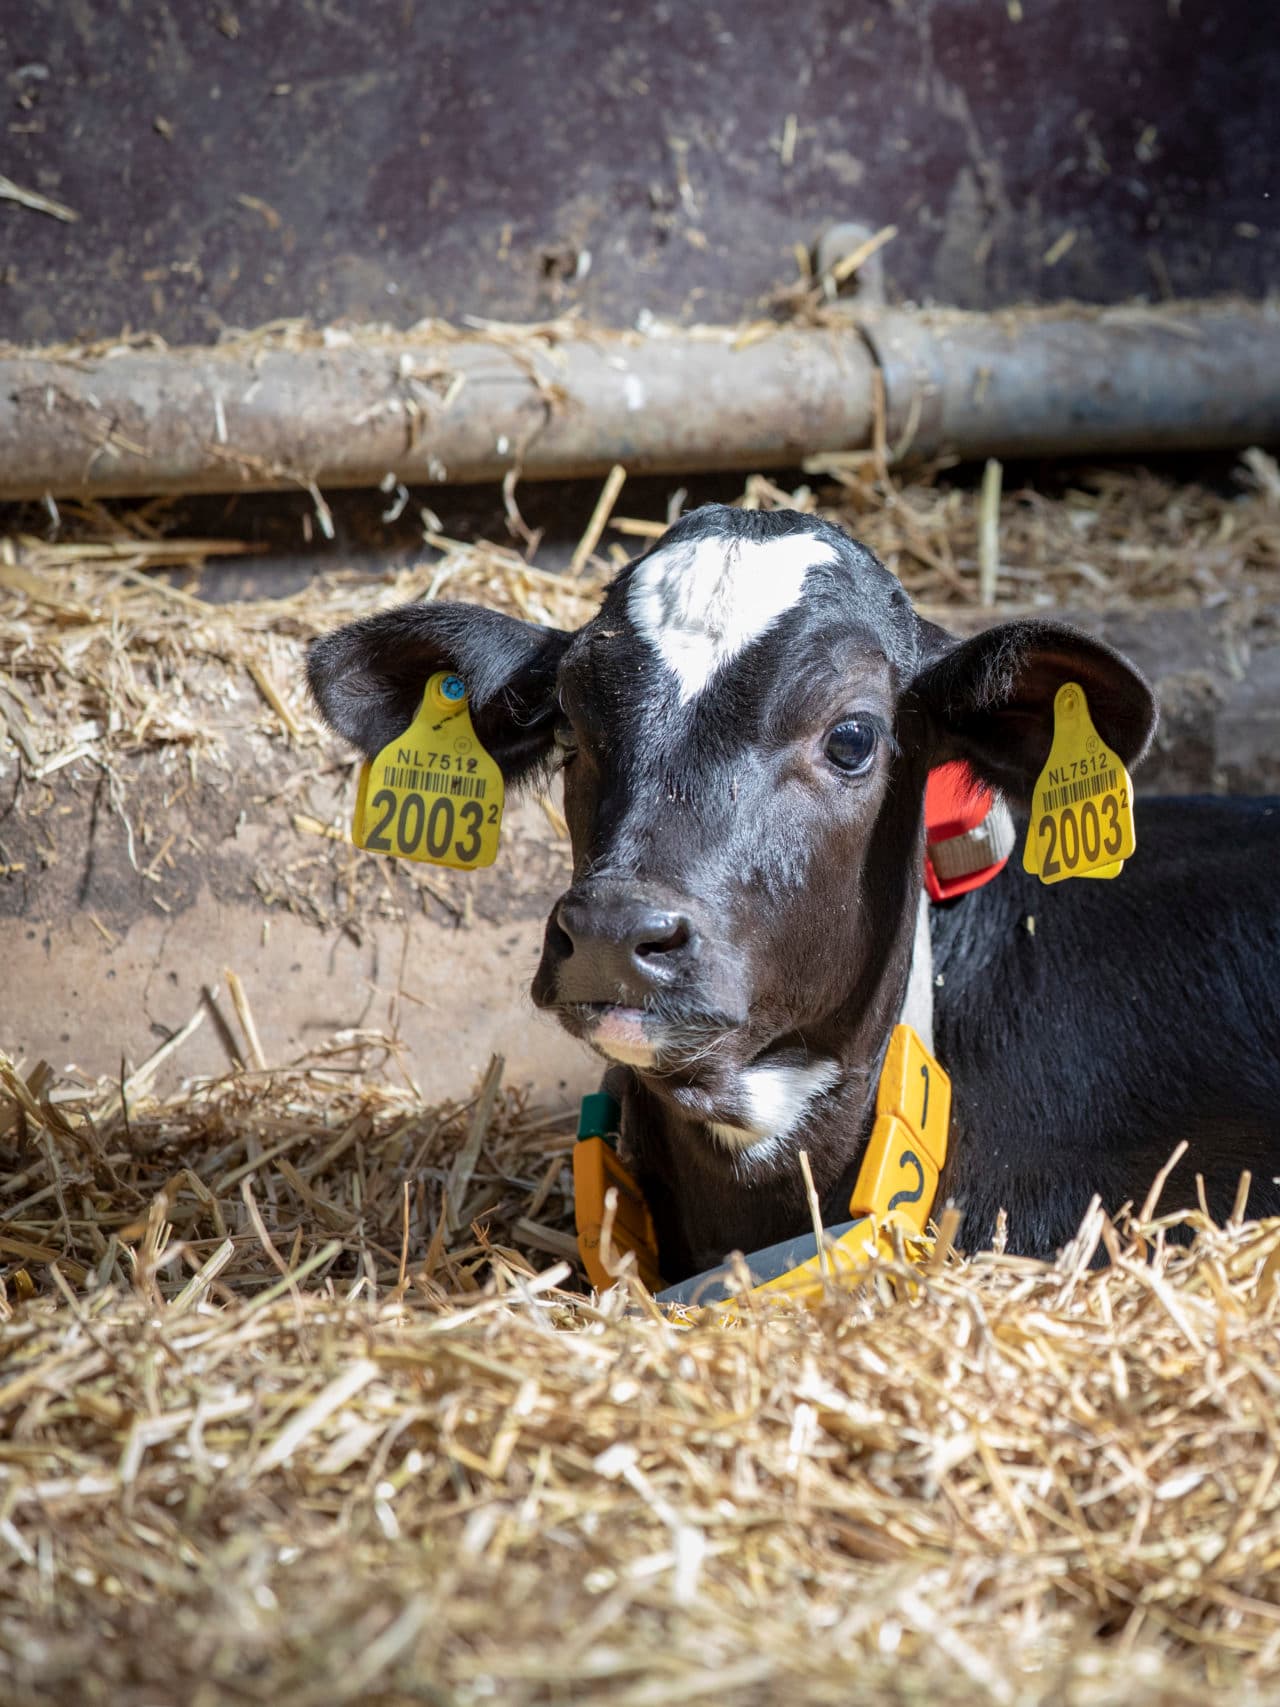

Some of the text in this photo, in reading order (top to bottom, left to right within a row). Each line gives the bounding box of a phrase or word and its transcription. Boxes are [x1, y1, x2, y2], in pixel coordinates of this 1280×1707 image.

[397, 749, 478, 774] NL7512
[1048, 753, 1108, 786] NL7512
[364, 789, 499, 862] 2003 2
[1038, 788, 1129, 878] 2003 2
[920, 1064, 930, 1131] 1
[887, 1150, 925, 1212] 2
